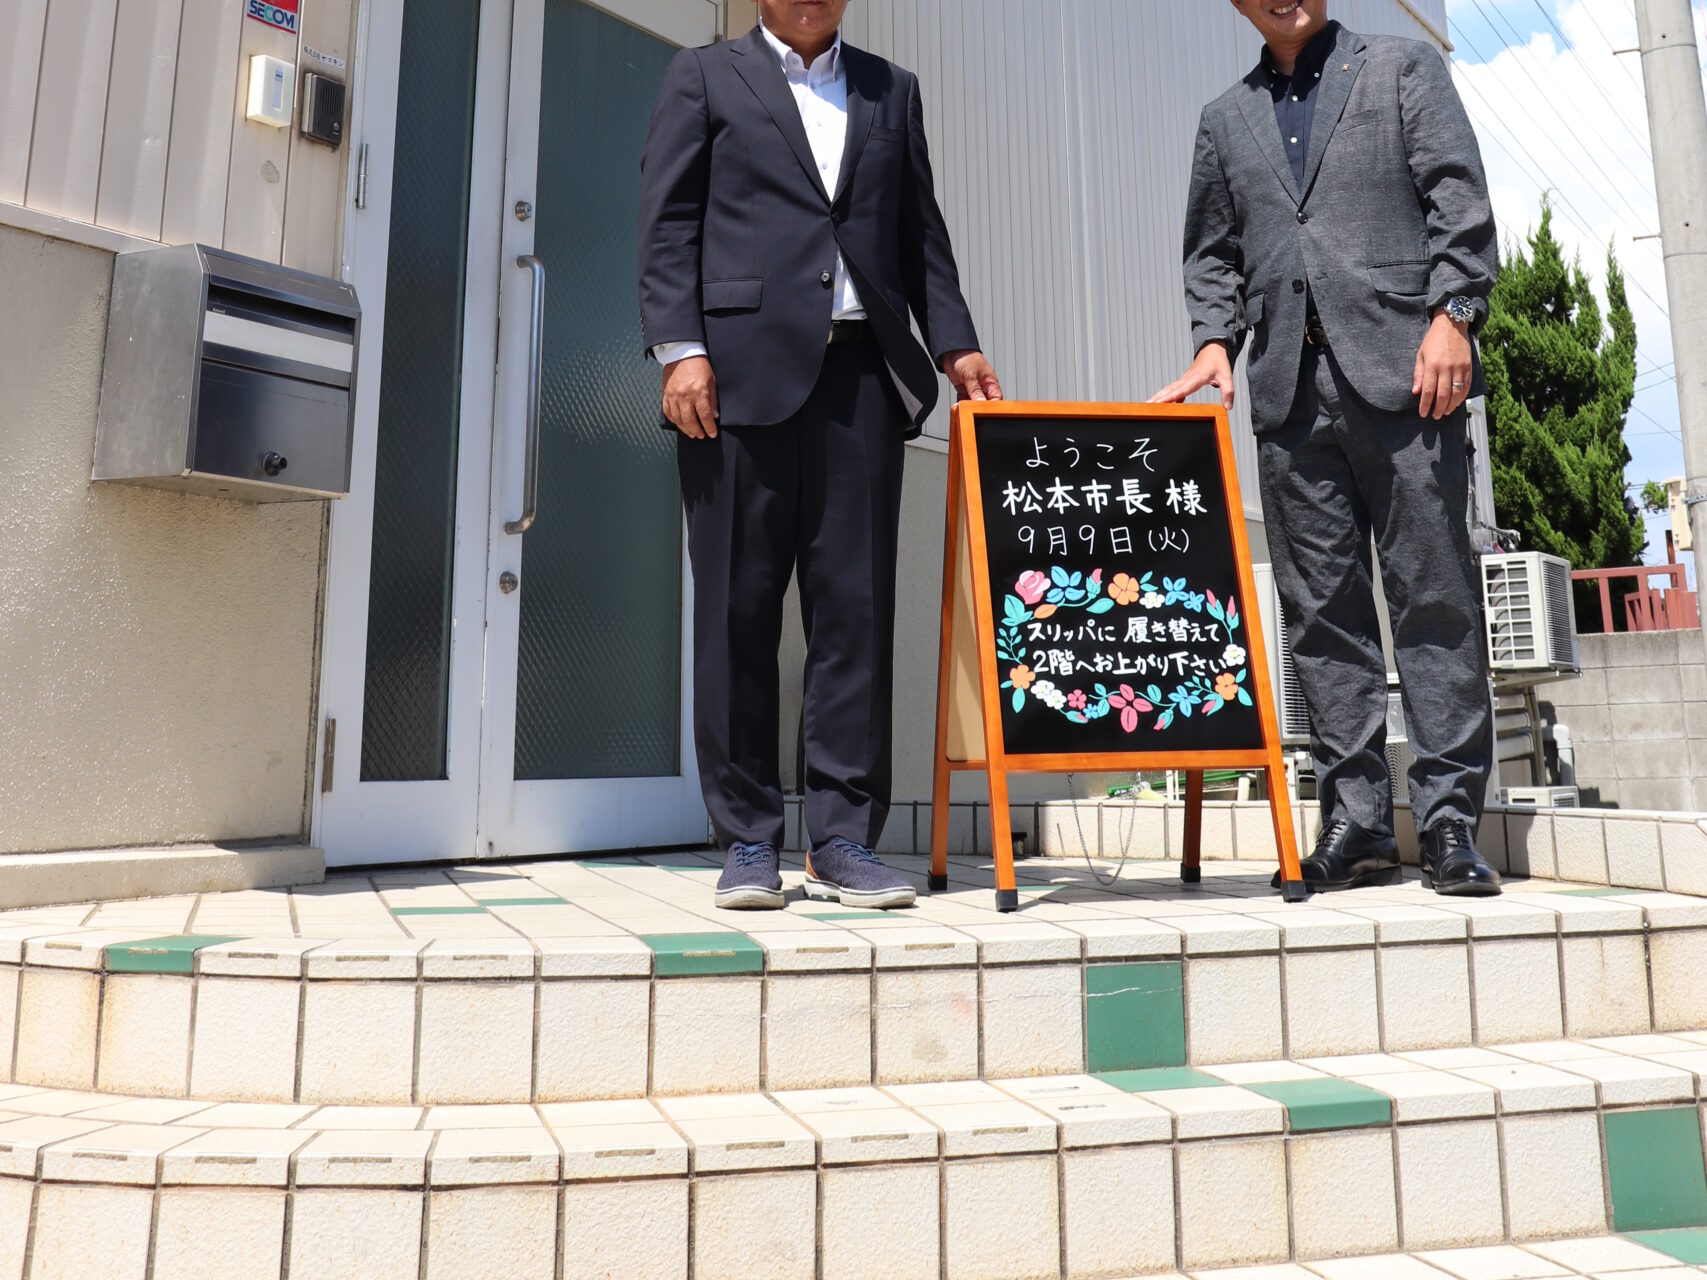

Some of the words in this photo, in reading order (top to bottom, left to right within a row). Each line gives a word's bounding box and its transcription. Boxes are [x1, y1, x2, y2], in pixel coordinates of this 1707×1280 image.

[249, 0, 295, 29] SECOM
[1025, 436, 1158, 472] ようこそ
[1002, 476, 1153, 516] 松本市長
[1165, 478, 1207, 516] 様
[1026, 619, 1117, 642] スリッパに
[1123, 616, 1220, 644] 履き替えて
[1032, 648, 1228, 677] 2階へお上がり下さい
